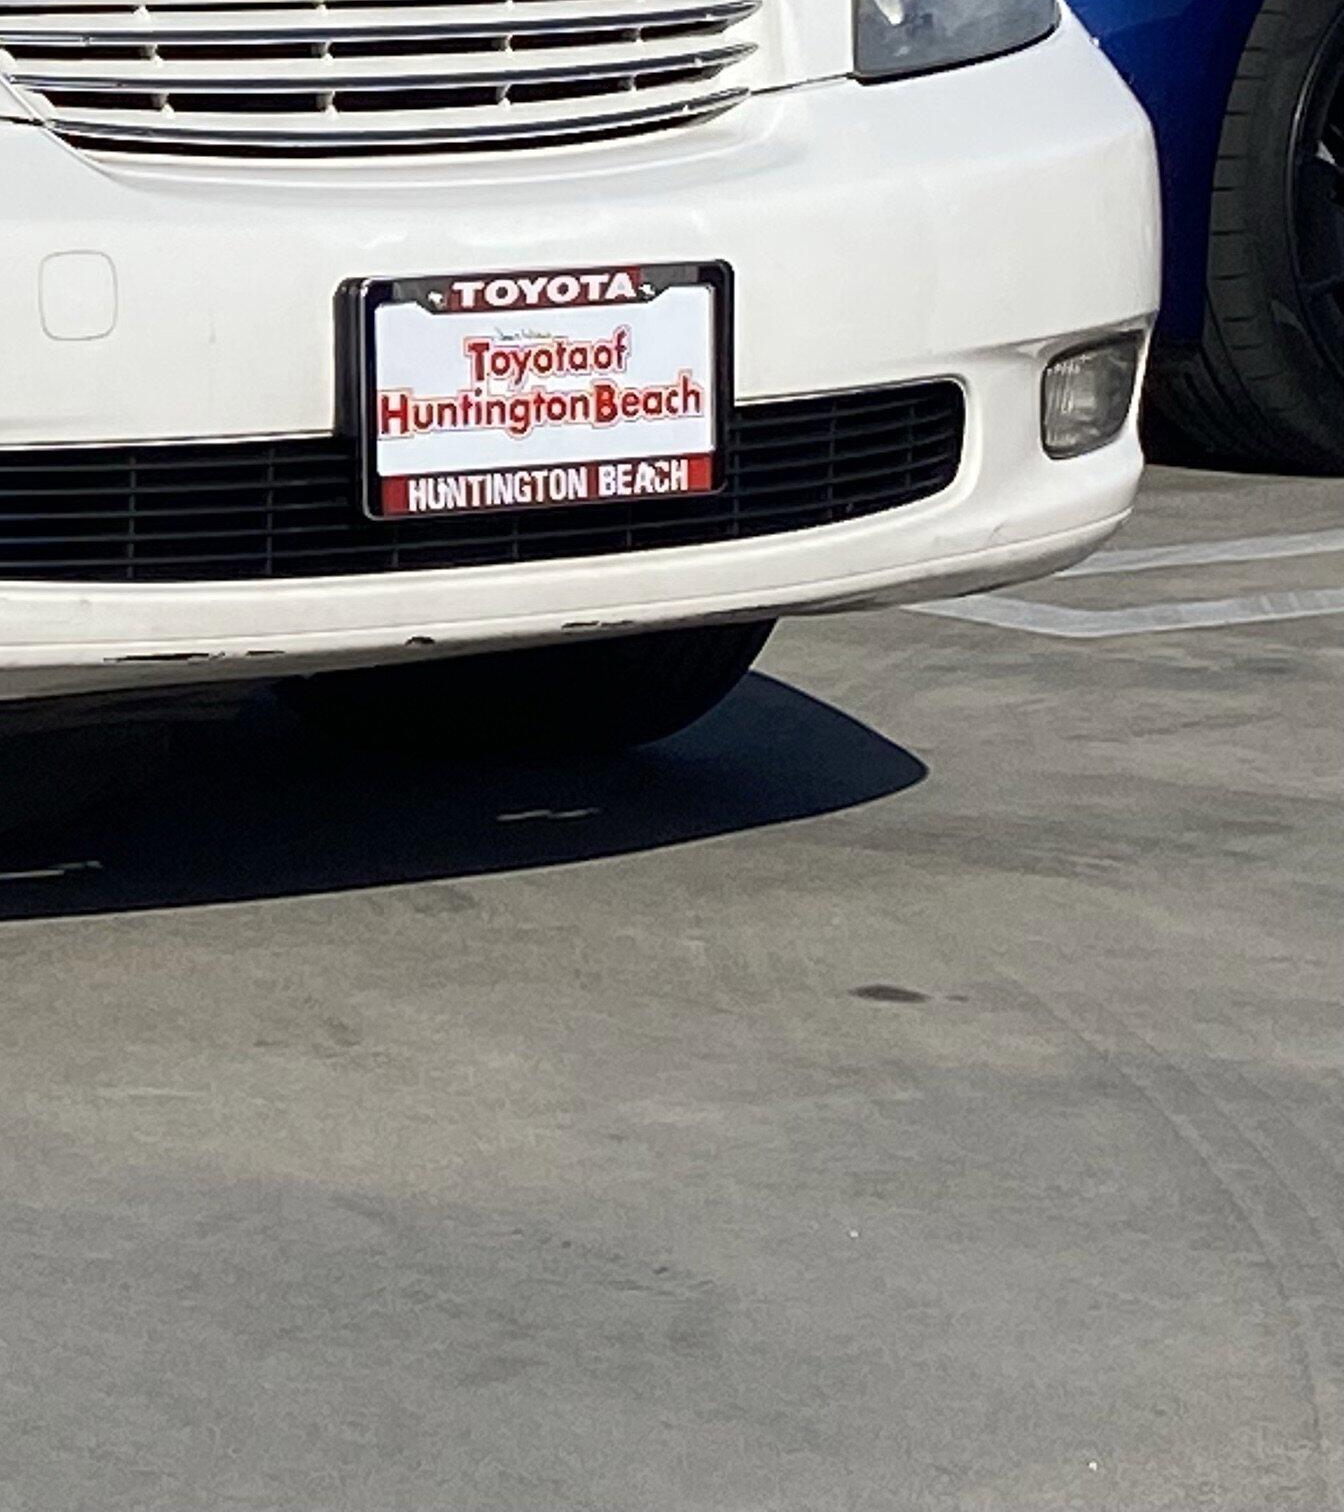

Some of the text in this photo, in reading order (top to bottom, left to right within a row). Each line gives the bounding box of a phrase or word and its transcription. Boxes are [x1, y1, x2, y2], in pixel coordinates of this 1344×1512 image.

[452, 272, 637, 308] TOYOTA
[408, 459, 689, 512] HUNTINGTON BEACH
